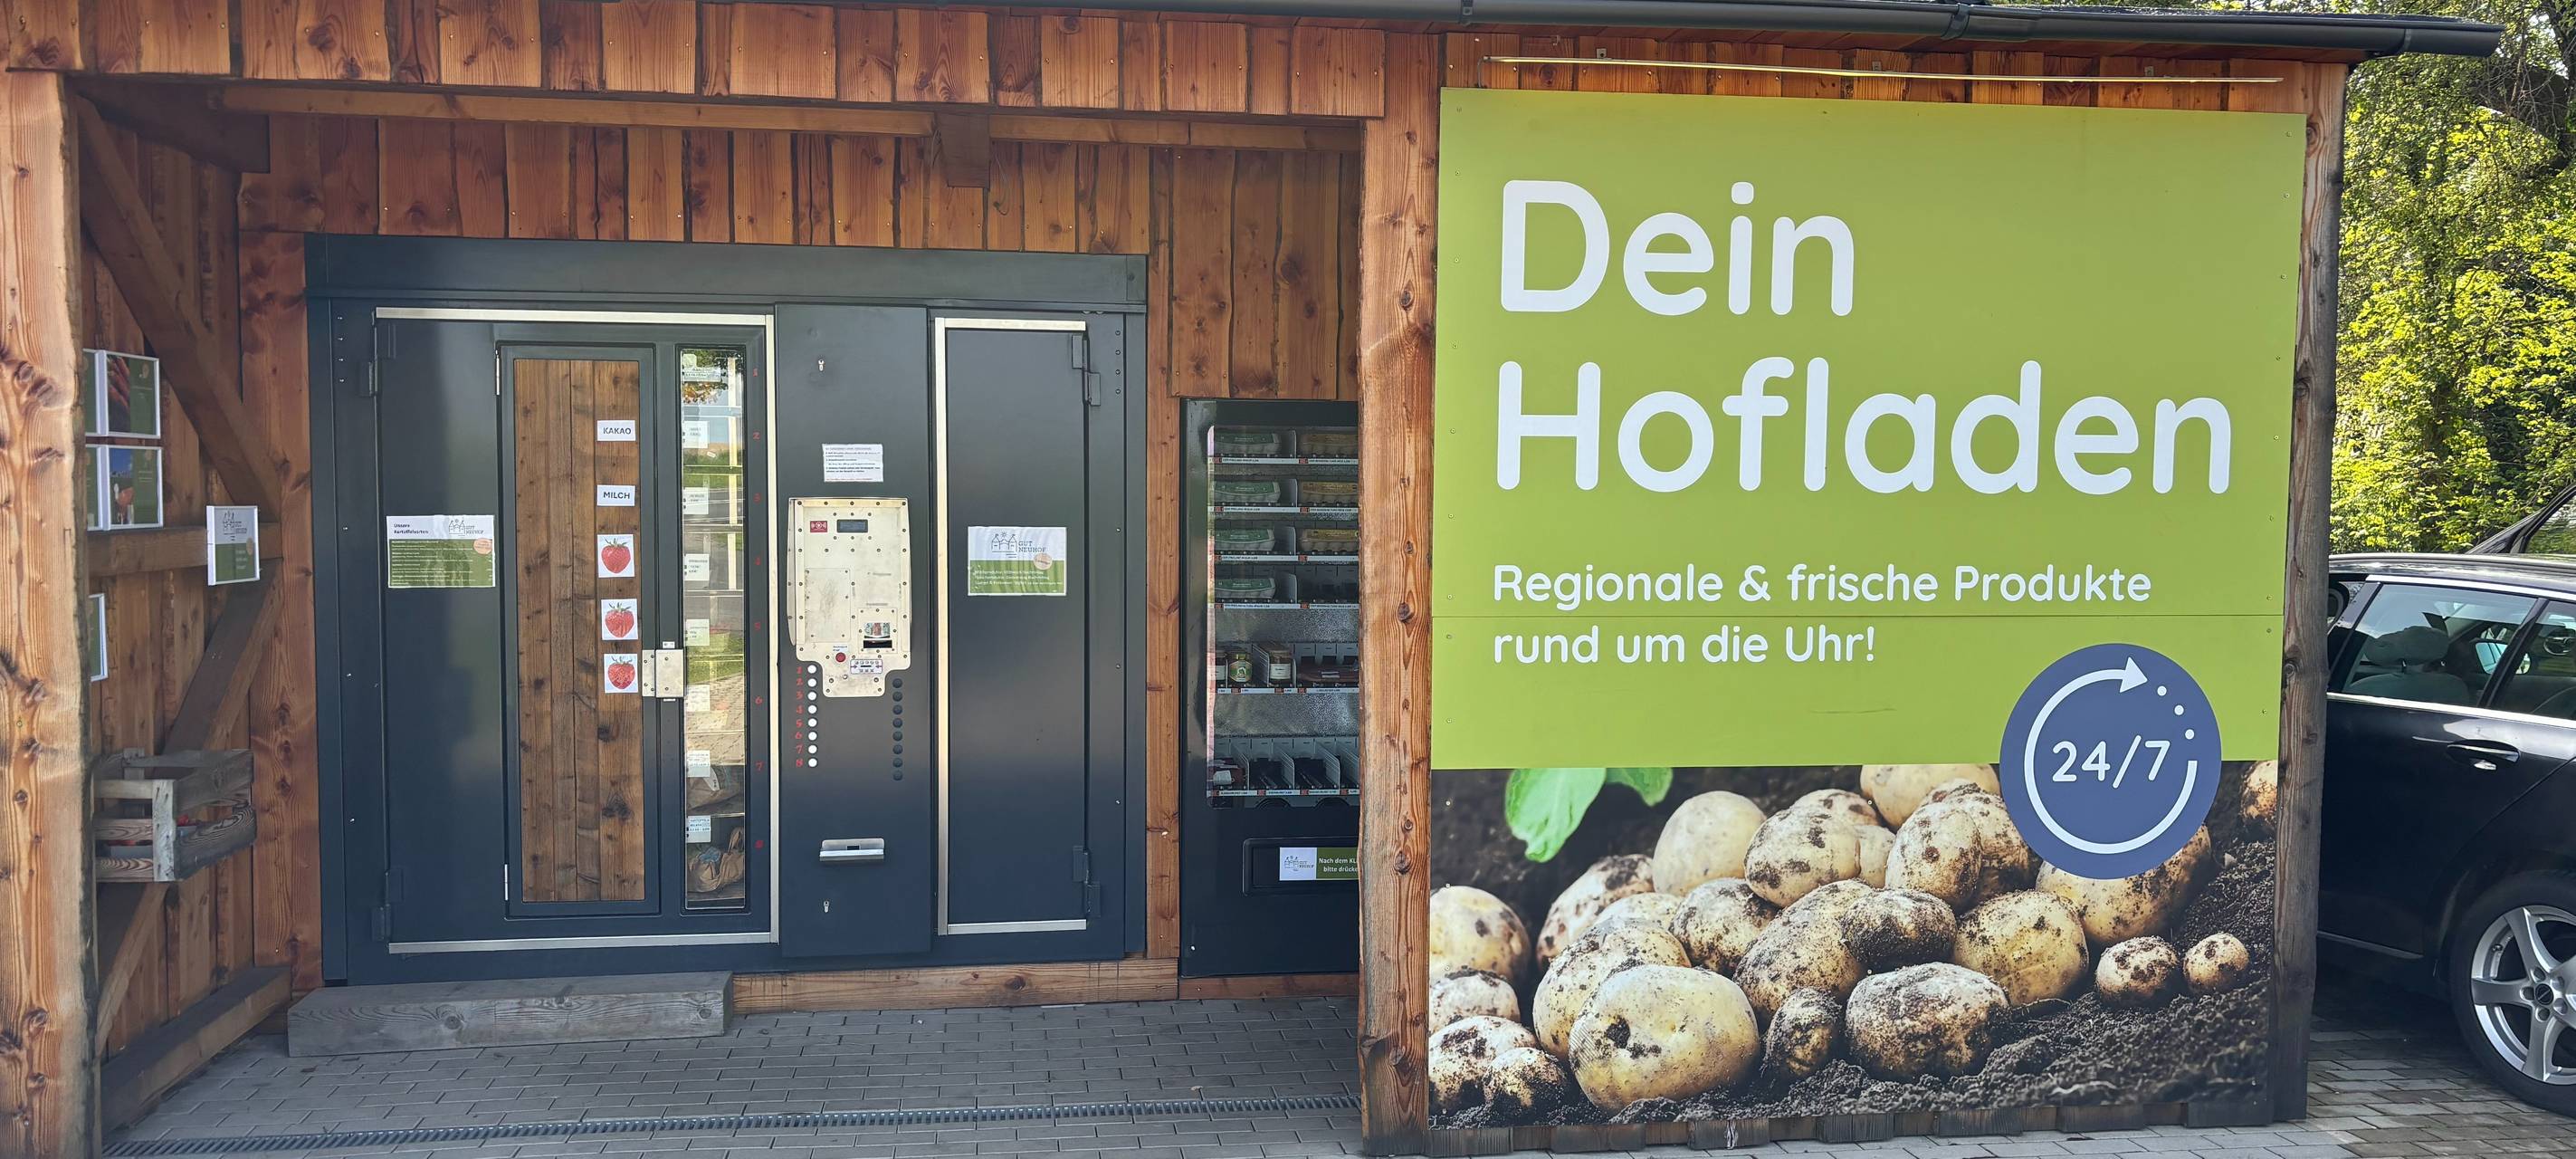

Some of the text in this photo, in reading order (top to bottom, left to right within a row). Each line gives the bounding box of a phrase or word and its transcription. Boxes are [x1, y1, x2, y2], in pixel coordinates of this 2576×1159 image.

[1501, 179, 1855, 317] Dein
[1497, 357, 2232, 495] Hofladen
[1493, 563, 2151, 611] Regionale & frische Produkte
[1494, 624, 1875, 664] rund um die Uhr!
[2052, 734, 2171, 789] 24/7
